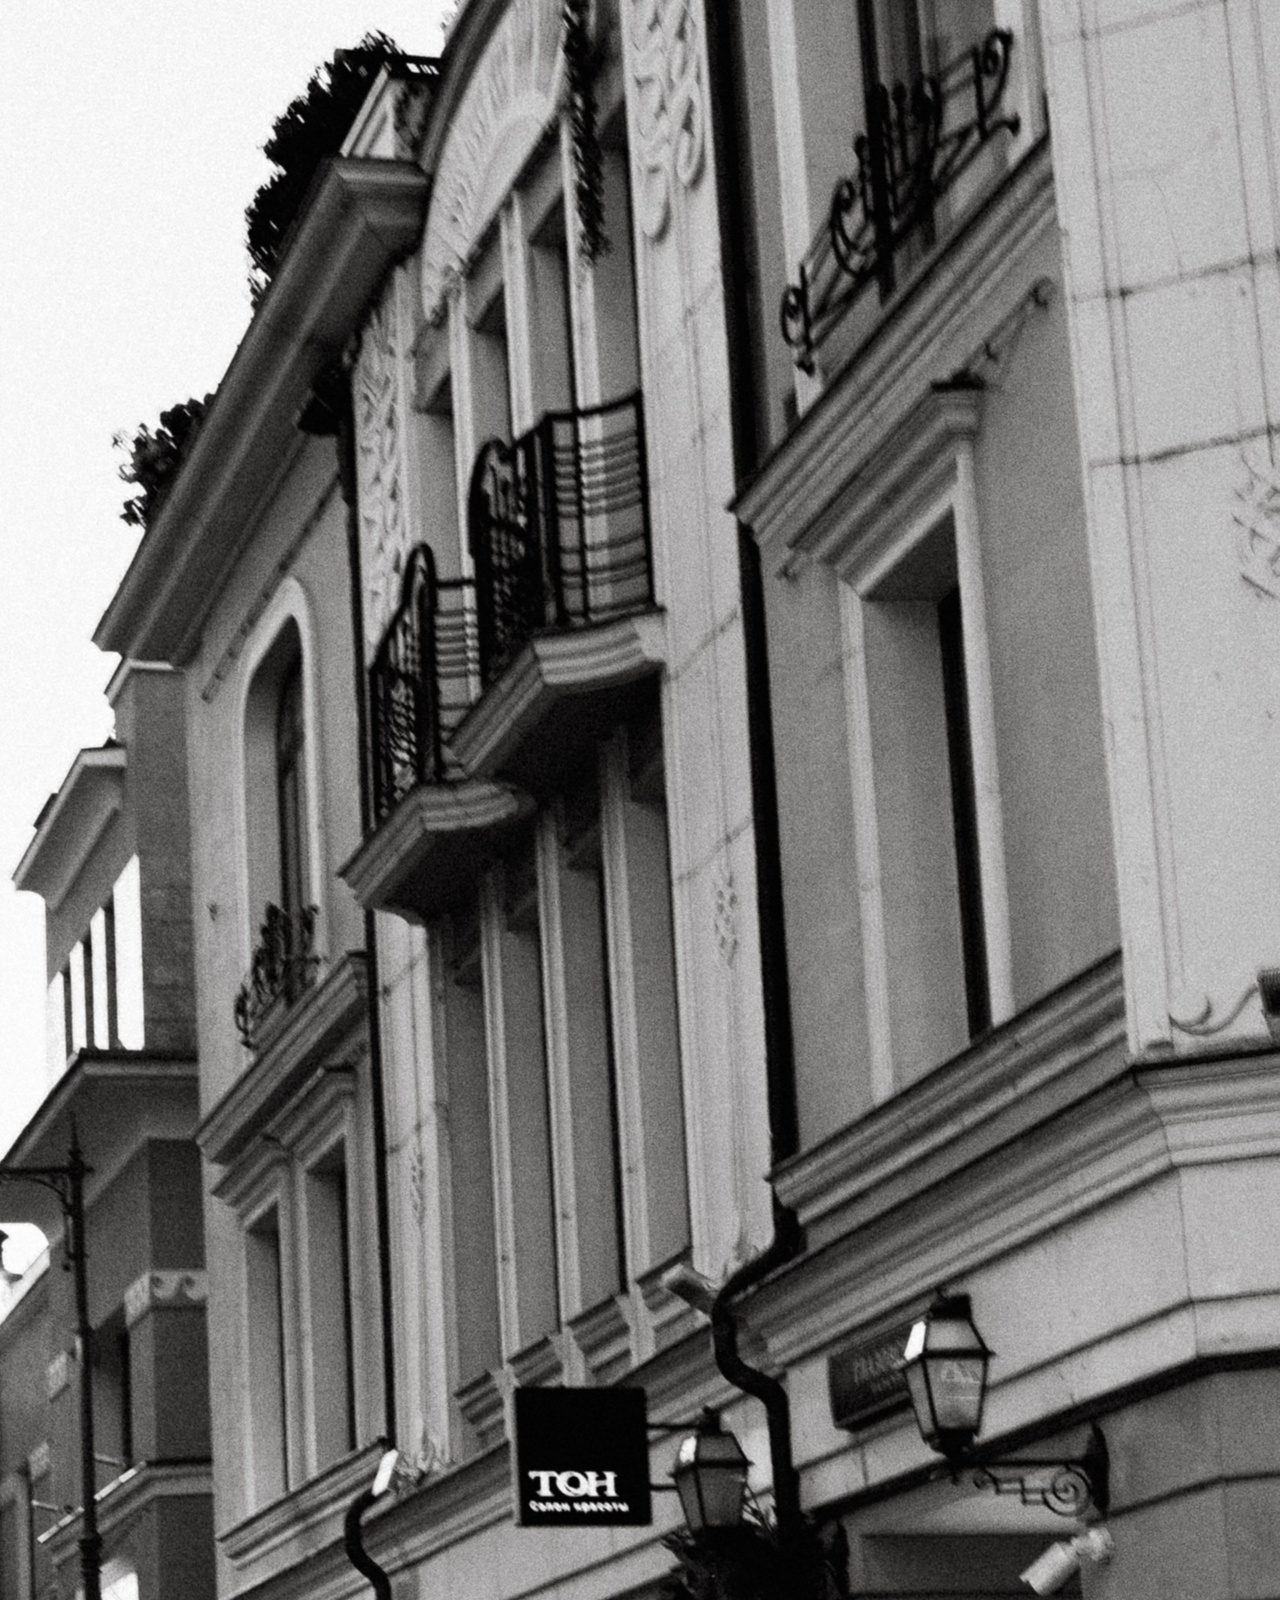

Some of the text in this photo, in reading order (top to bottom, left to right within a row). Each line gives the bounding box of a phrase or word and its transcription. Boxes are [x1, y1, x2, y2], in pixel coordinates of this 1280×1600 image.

[528, 1470, 619, 1497] ТОН
[529, 1500, 630, 1514] Салон красоты
